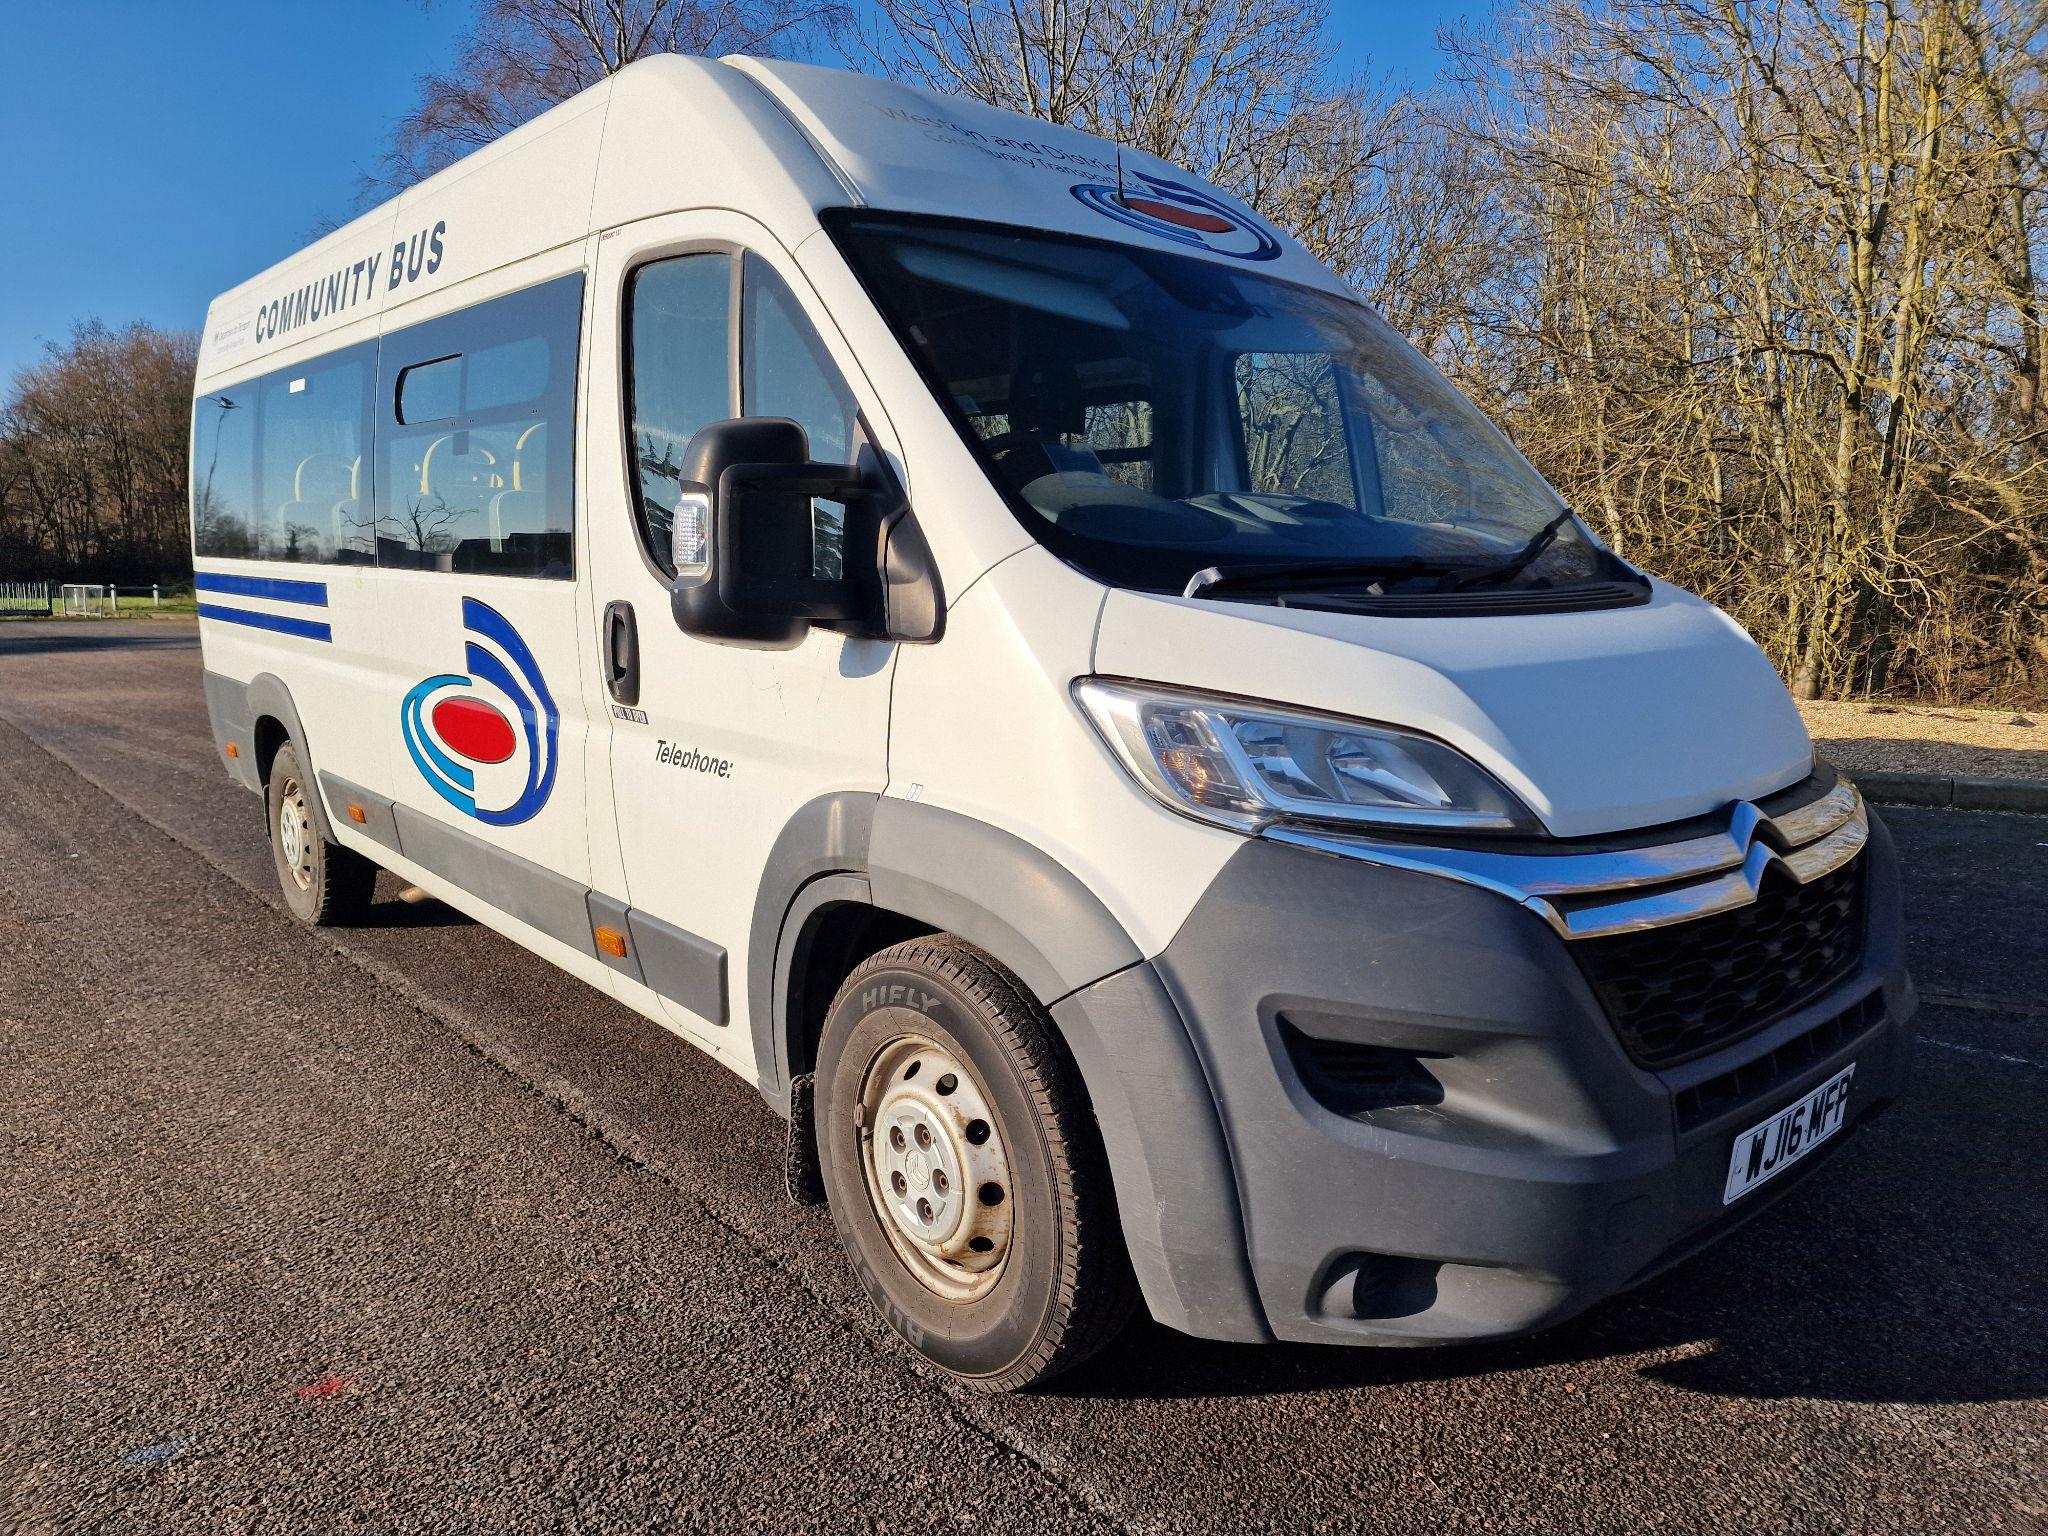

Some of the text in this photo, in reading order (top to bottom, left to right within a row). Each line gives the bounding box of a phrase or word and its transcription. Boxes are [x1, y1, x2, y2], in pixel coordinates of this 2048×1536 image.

[923, 130, 1035, 168] Community
[1033, 157, 1118, 185] Transport
[991, 135, 1041, 154] and
[256, 220, 446, 344] COMMUNITY BUS
[655, 739, 734, 779] Telephone:
[862, 985, 942, 1013] HIFLY
[1745, 1105, 1806, 1184] WJ16
